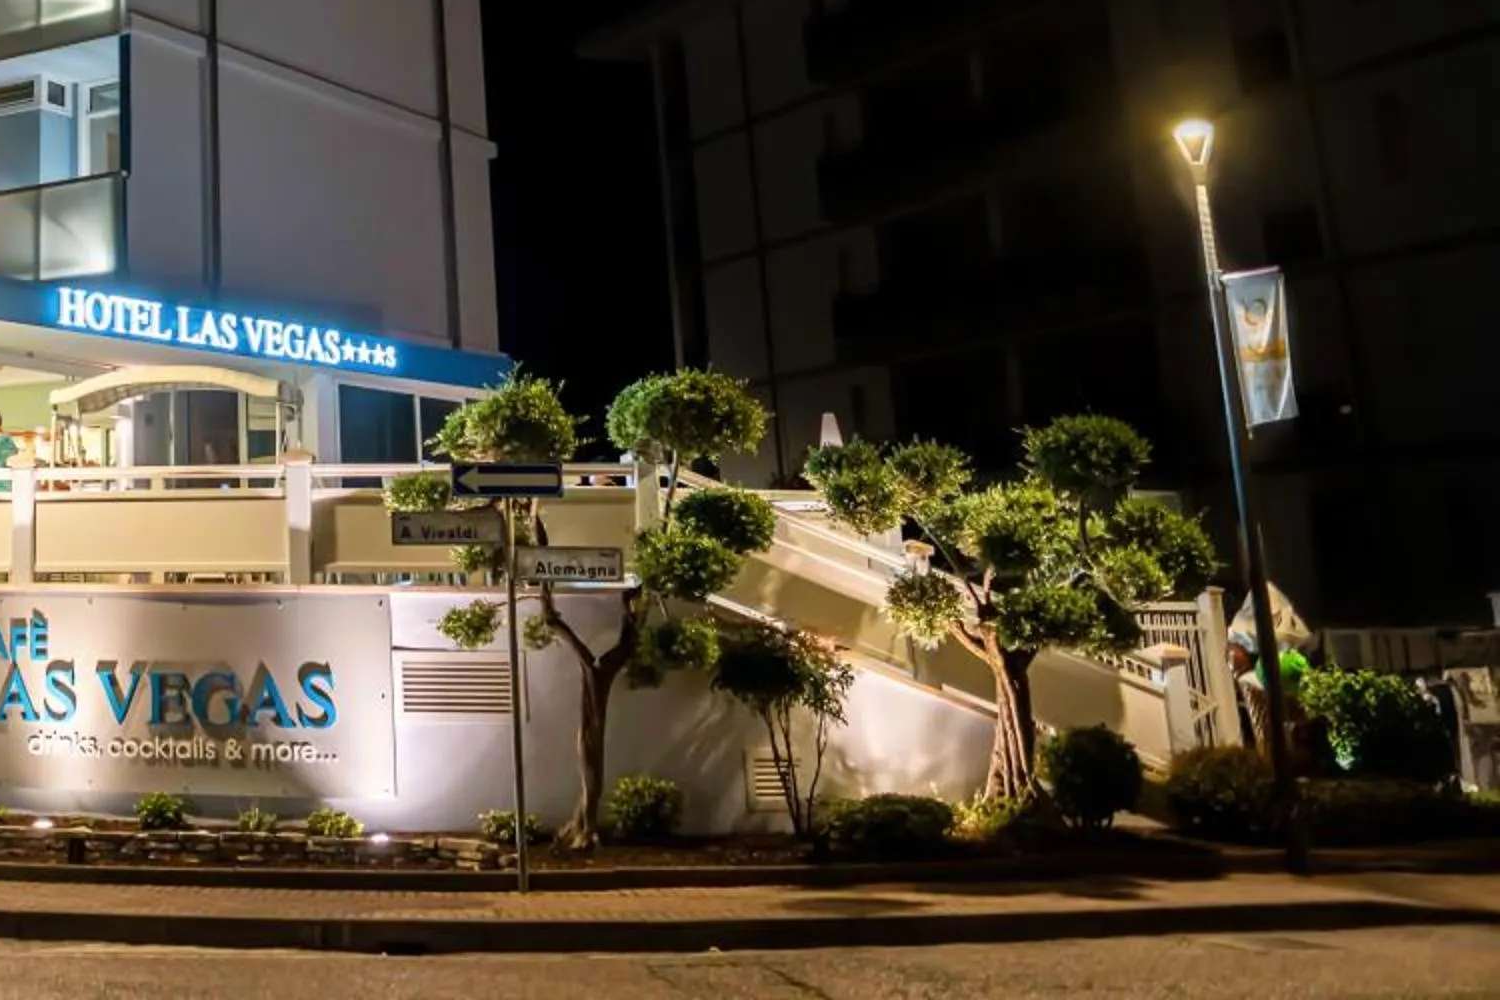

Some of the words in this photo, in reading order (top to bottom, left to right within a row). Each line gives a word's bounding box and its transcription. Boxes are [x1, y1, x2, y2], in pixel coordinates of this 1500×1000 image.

[57, 286, 172, 341] HOTEL
[176, 306, 239, 350] LAS
[242, 317, 341, 366] VEGAS
[535, 561, 617, 579] Alemagna
[96, 660, 337, 729] VEGAS
[108, 735, 215, 760] cocktails
[225, 737, 243, 760] &
